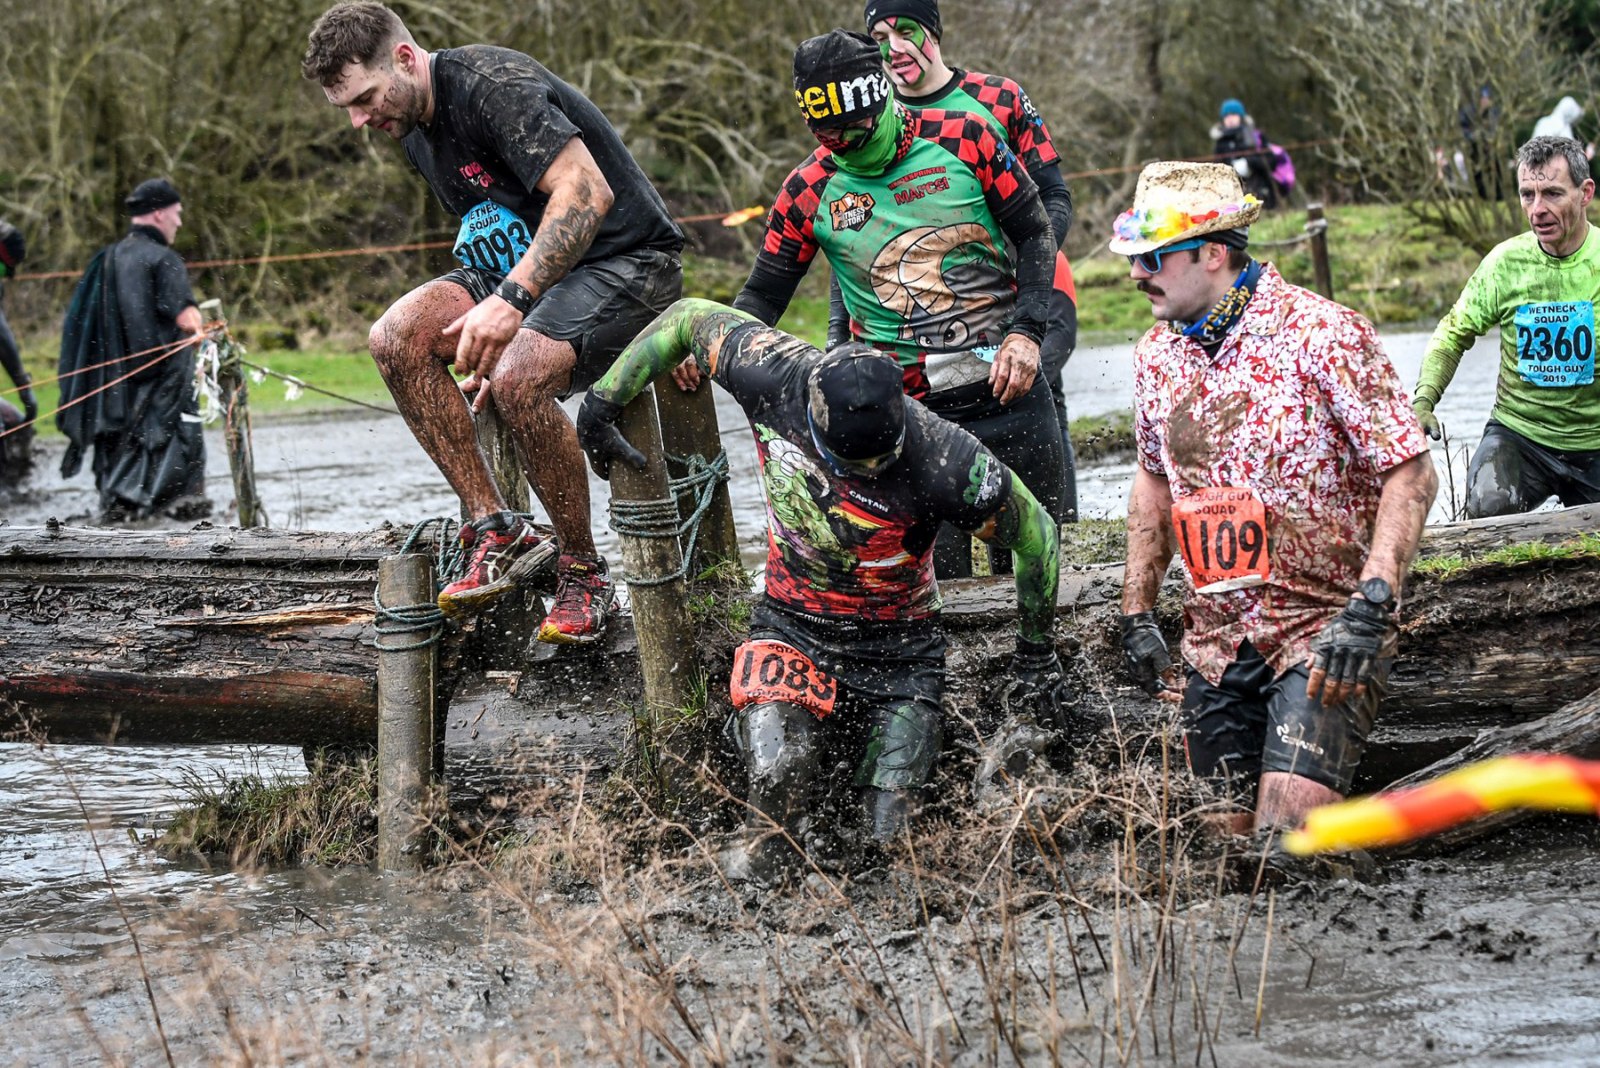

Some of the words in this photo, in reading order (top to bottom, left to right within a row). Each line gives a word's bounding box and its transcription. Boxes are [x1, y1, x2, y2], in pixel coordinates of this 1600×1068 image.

[469, 213, 500, 233] SQUAD
[1529, 305, 1577, 315] WETNECK
[1534, 315, 1569, 324] SQUAD
[1518, 324, 1592, 362] 2360
[1528, 364, 1561, 373] TOUGH
[1564, 365, 1586, 373] GUY
[1543, 375, 1566, 383] 2019
[1227, 491, 1254, 501] GUY
[1194, 505, 1236, 515] SQUAD
[1180, 520, 1263, 570] 1109
[740, 650, 834, 701] 1083
